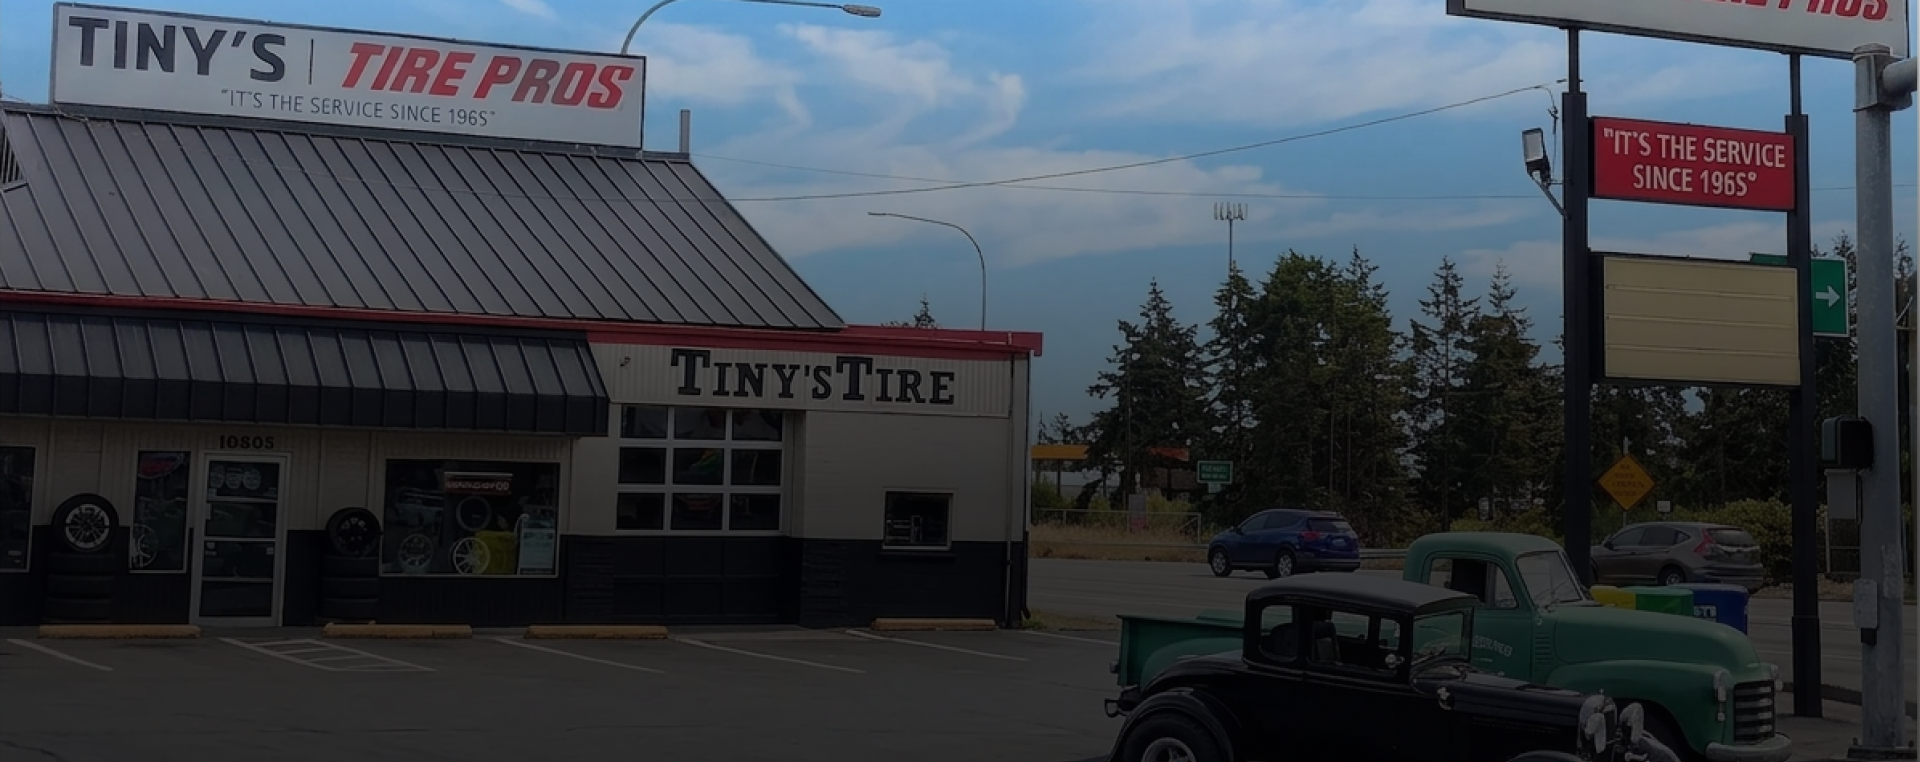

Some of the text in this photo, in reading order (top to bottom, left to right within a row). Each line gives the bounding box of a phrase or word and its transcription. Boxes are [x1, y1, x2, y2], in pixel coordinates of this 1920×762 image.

[69, 16, 635, 109] TINY'S TIRE PROS
[269, 93, 304, 113] THE
[310, 97, 383, 118] SERVICE
[390, 104, 441, 123] SINCE
[1656, 134, 1698, 161] THE
[1703, 137, 1787, 168] SERVICE
[1632, 163, 1694, 192] SINCE
